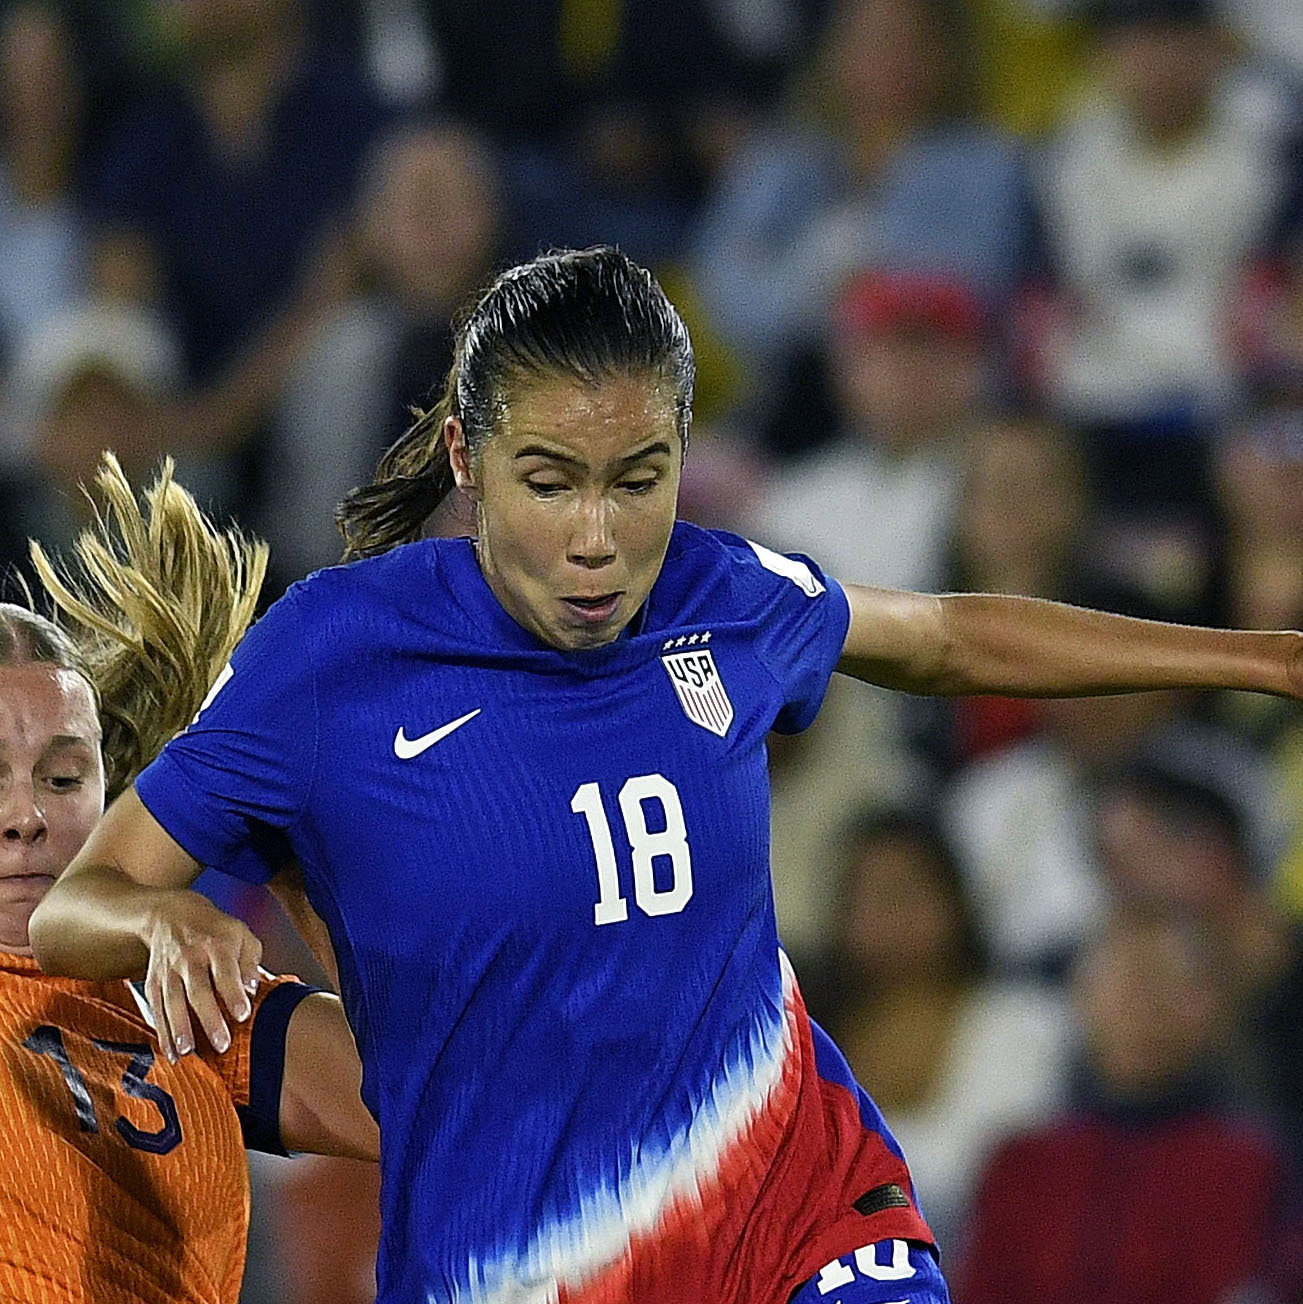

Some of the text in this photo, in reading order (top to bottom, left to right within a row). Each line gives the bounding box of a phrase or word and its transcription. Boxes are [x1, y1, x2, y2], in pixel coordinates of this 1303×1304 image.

[667, 655, 714, 688] USA
[570, 773, 694, 926] 18
[22, 1025, 184, 1156] 13
